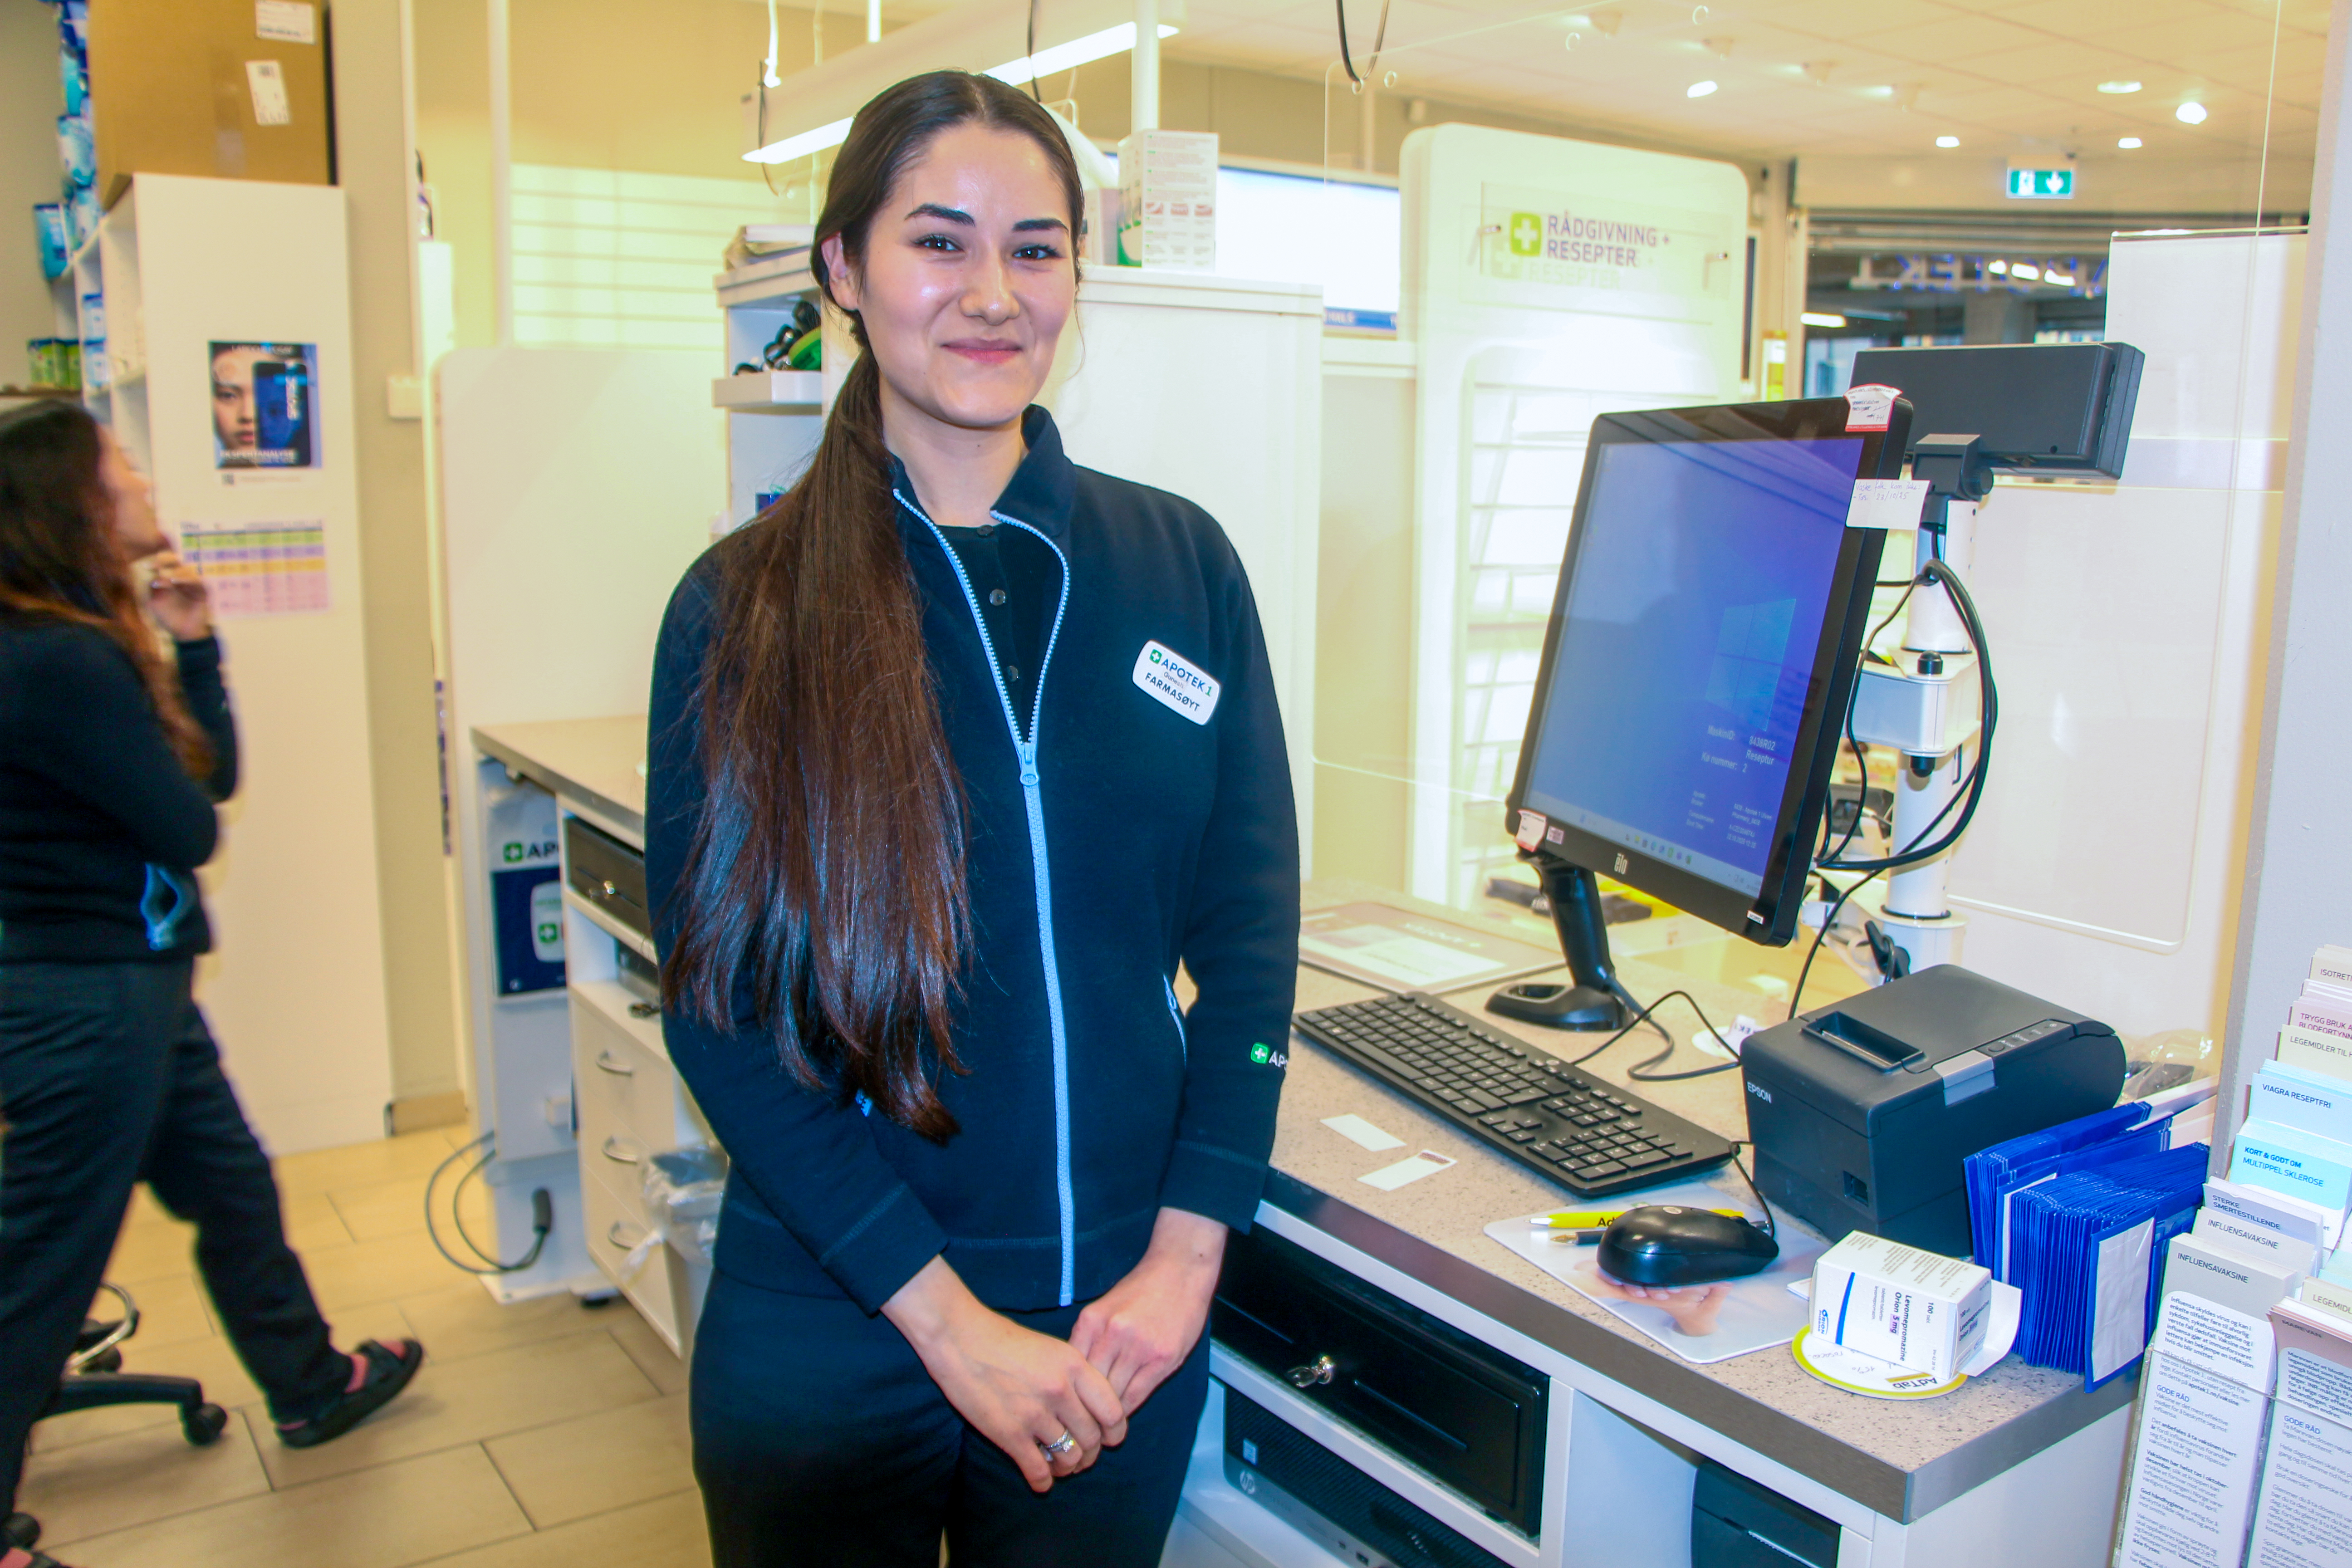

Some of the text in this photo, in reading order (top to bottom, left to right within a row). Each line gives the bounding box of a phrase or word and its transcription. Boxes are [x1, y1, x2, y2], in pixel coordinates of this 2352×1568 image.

[1547, 210, 1657, 247] RÅDGIVNING
[1548, 239, 1637, 267] RESEPTER
[1161, 658, 1212, 697] APOTEK 1
[1145, 672, 1200, 711] FARMASØYT
[1745, 749, 1774, 765] Reseptur
[2300, 1013, 2325, 1024] TRYGG
[2326, 1019, 2346, 1029] BRUK
[2290, 1035, 2336, 1053] LEGEMIDLER
[2337, 1048, 2347, 1057] TIL
[1747, 1081, 1771, 1103] EPSON
[2262, 1083, 2332, 1109] VIAGRA RESEPTFRI
[2244, 1147, 2263, 1157] KORT
[2270, 1154, 2290, 1165] GODT
[2289, 1160, 2302, 1169] OM
[2243, 1157, 2324, 1187] MULTIPPEL SKLEROSE
[2212, 1195, 2240, 1209] STERKE
[2213, 1202, 2281, 1230] SMERTESTILLENDE
[2208, 1219, 2278, 1250] INFLUENSAVAKSINE
[2177, 1252, 2249, 1284] INFLUENSAVAKSINE
[1894, 1292, 1902, 1313] Orion
[2171, 1296, 2195, 1309] Influensa
[2195, 1307, 2215, 1317] skyldes
[1890, 1321, 1898, 1334] mg
[1900, 1295, 1912, 1362] Levomepromazine
[2170, 1304, 2189, 1314] enkelte
[2190, 1312, 2209, 1321] tilfeller
[2229, 1327, 2249, 1338] alvorlig
[2191, 1320, 2242, 1342] sykehusinnleggelse
[2281, 1319, 2322, 1338] MAREVAN
[2165, 1337, 2175, 1345] hvis
[2168, 1318, 2184, 1327] verste
[2218, 1336, 2238, 1348] Vaksine
[2166, 1330, 2183, 1340] lettere
[2194, 1341, 2220, 1355] bekjempe
[2228, 1355, 2253, 1368] infeksjon
[2209, 1340, 2251, 1360] immunforsvaret
[1892, 1377, 1938, 1389] AdTab
[2156, 1385, 2189, 1402] GODE RÅD
[2167, 1374, 2181, 1382] dette
[2188, 1383, 2239, 1406] apotek1.no/vaksine
[2284, 1415, 2320, 1434] GODE RÅD
[2147, 1449, 2169, 1462] Vaksinen
[2180, 1464, 2193, 1473] helst
